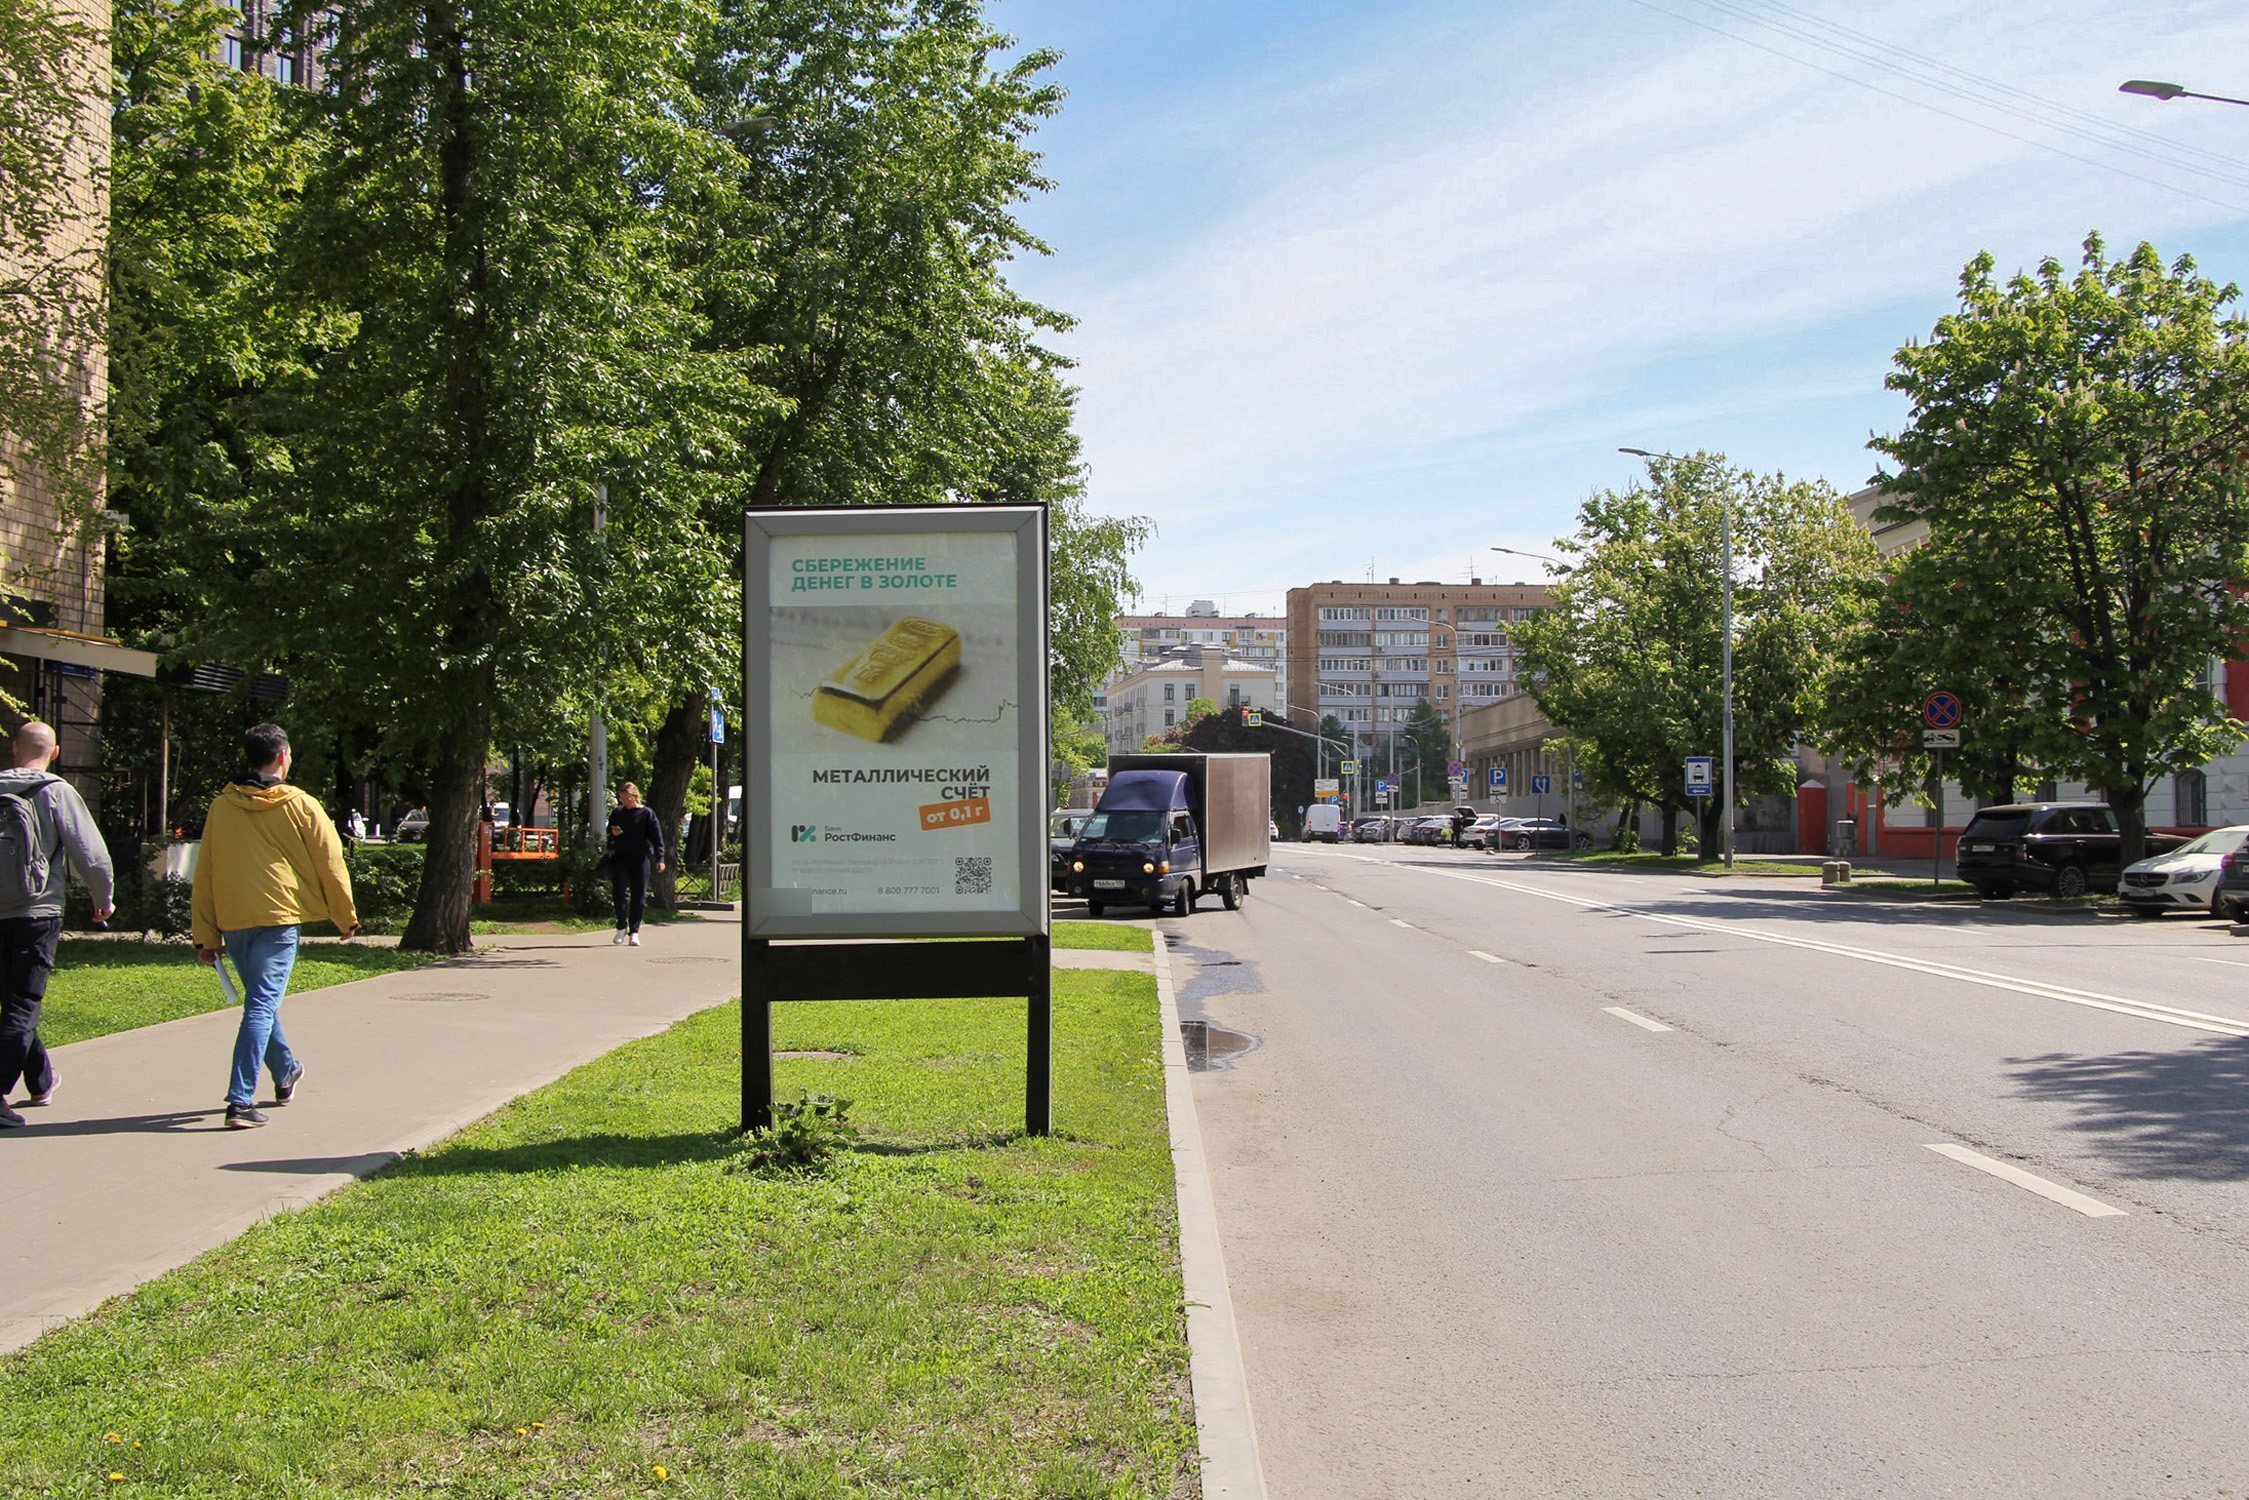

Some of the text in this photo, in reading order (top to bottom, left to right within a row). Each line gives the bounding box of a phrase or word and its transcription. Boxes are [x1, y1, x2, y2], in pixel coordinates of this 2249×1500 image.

[791, 557, 926, 573] СБЕРЕЖЕНИЕ
[791, 574, 957, 592] ДЕНЕГ В ЗОЛОТЕ
[812, 765, 990, 783] МЕТАЛЛИЧЕСКИЙ
[941, 783, 990, 800] СЧЁТ
[926, 806, 984, 824] от 0,1 г
[824, 832, 897, 843] РостФинанс
[811, 888, 848, 896] nance.ru
[877, 887, 940, 895] 8 800 777 7001
